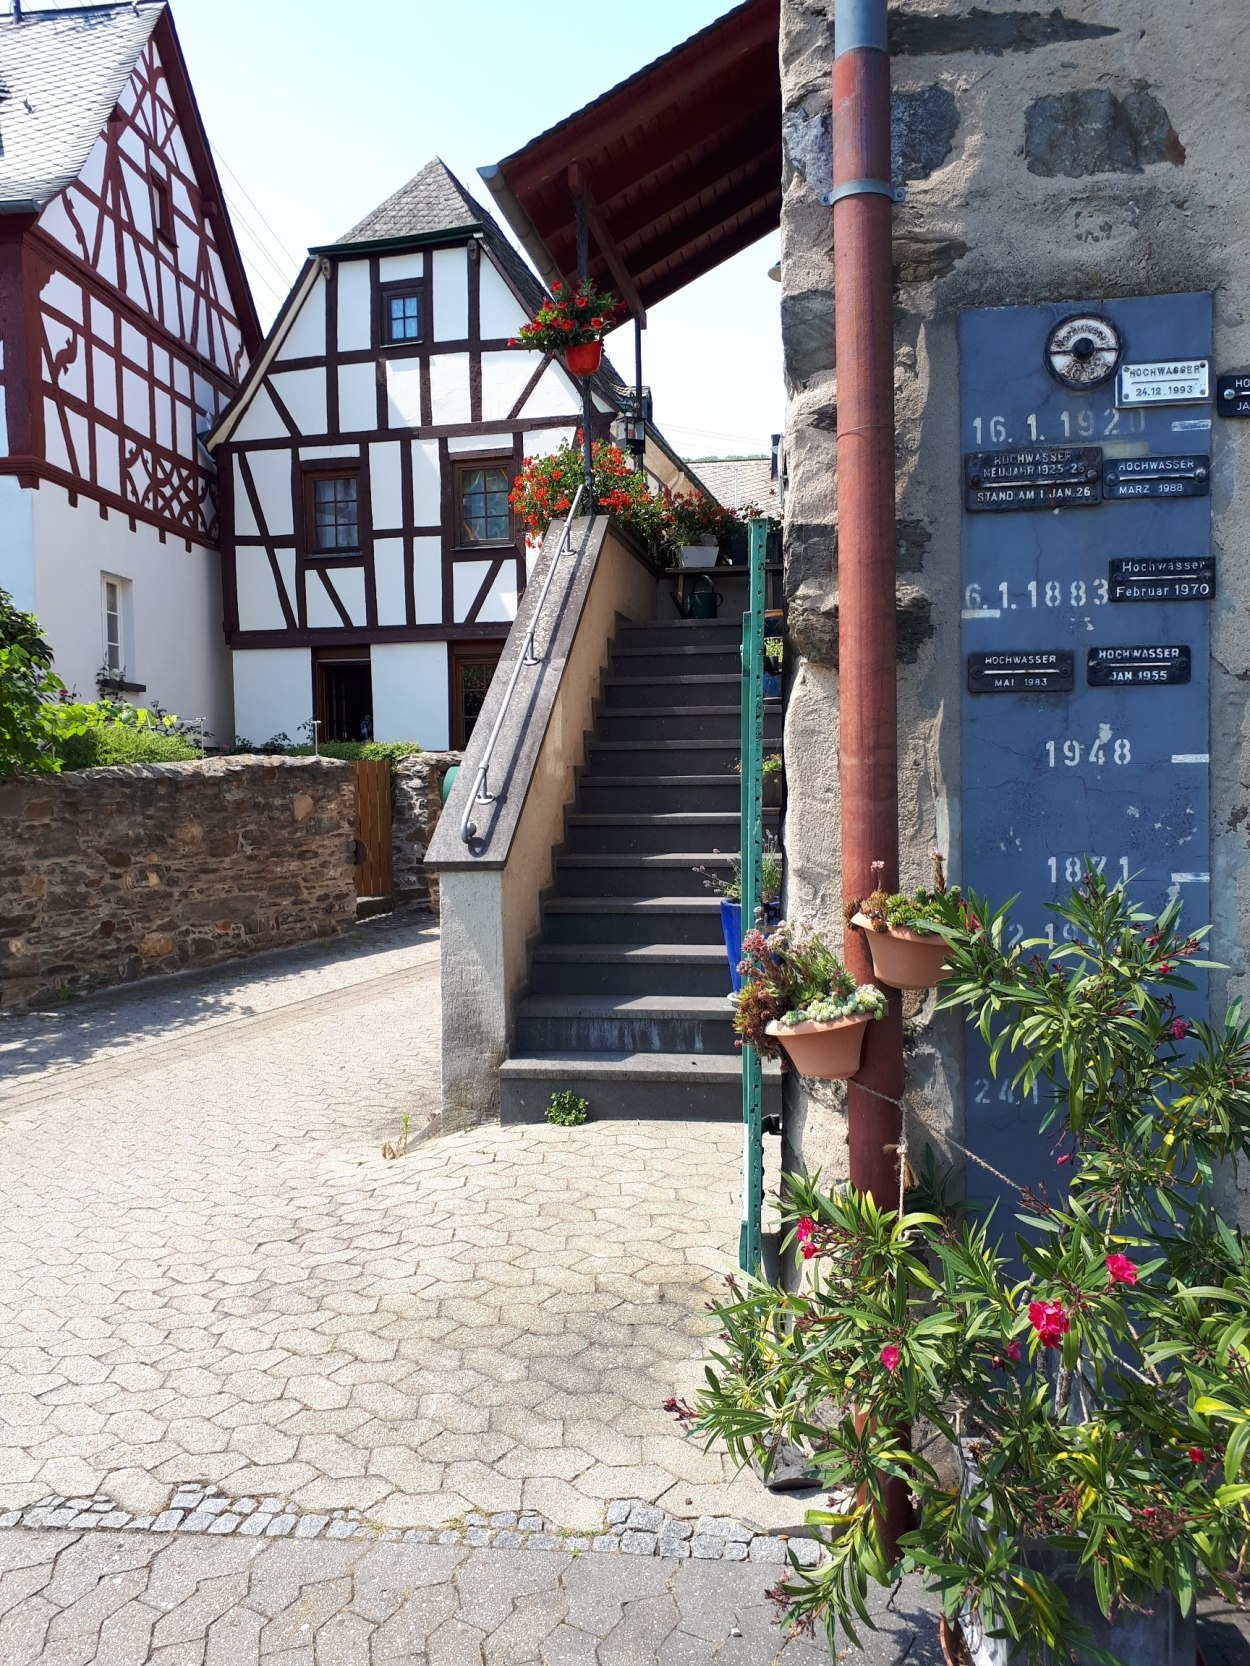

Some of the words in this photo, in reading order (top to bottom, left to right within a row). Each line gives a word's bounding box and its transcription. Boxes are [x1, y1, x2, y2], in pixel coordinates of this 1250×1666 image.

[1129, 364, 1201, 378] HOCHWASSER
[994, 450, 1072, 466] HOCHWASSER
[983, 465, 1034, 478] NEUJAHR
[1118, 460, 1194, 471] HOCHWASSER
[1119, 483, 1150, 494] MÄRZ
[1158, 483, 1184, 493] 1988
[977, 490, 1014, 502] STAND
[1018, 489, 1035, 500] AM
[1121, 560, 1206, 573] Hochwasser
[1116, 585, 1170, 598] Februar
[1174, 583, 1210, 596] 1970
[985, 655, 1057, 665] HOCHWASSER
[1098, 648, 1180, 659] HOCHWASSER
[994, 678, 1015, 687] MAI
[1024, 678, 1048, 687] 1983
[1109, 671, 1132, 682] JAN
[1137, 670, 1168, 681] 1955
[1045, 738, 1132, 768] 1948
[1047, 856, 1129, 883] 1871
